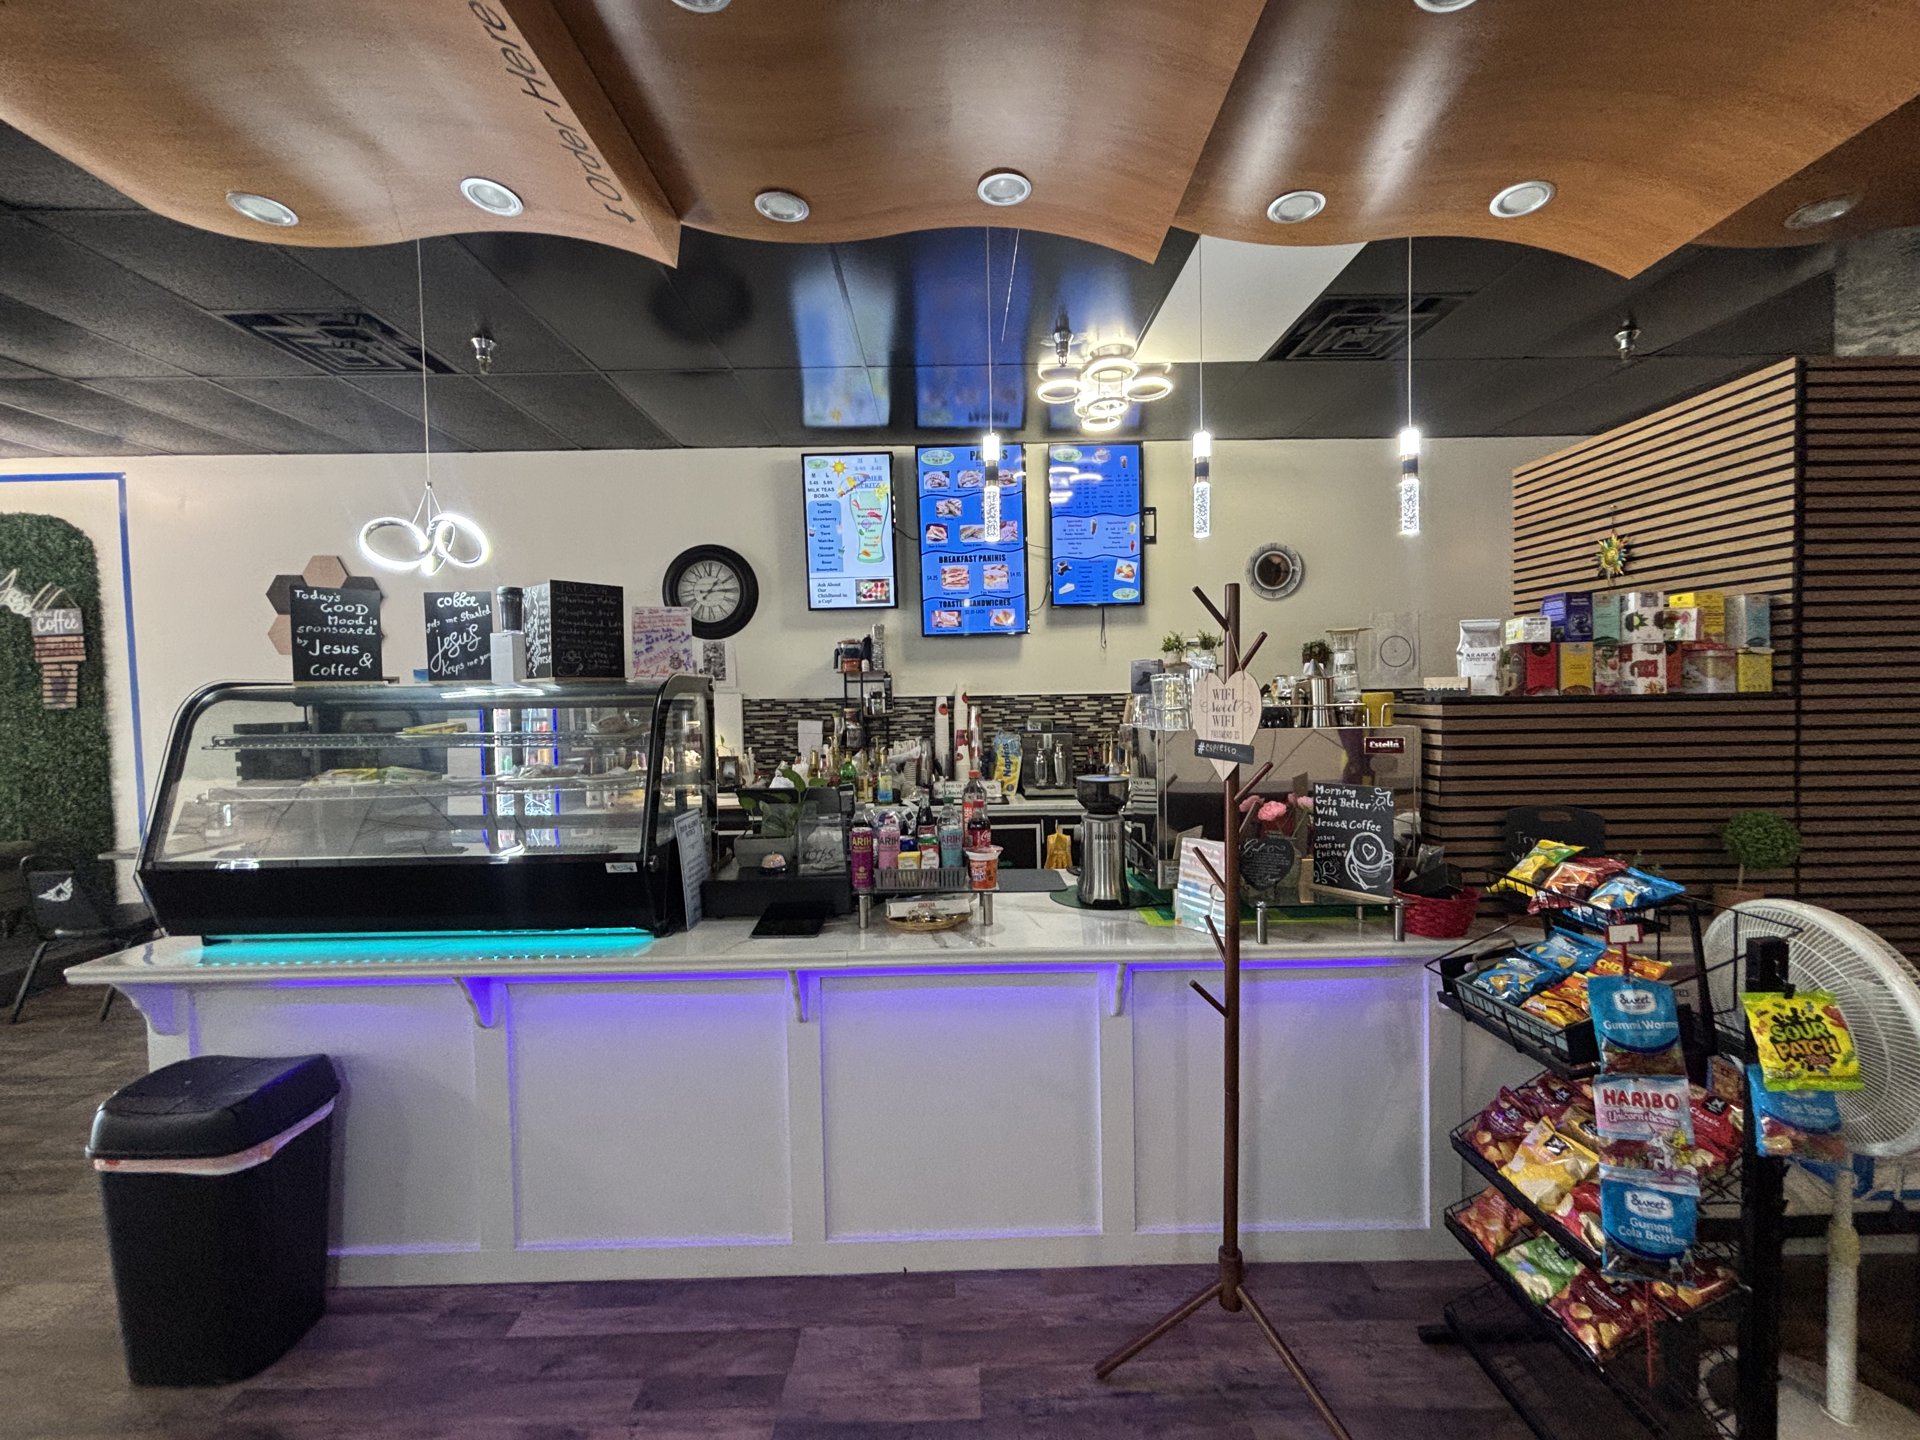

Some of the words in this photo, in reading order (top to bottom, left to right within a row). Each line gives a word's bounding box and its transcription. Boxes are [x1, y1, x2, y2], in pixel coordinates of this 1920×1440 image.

[469, 1, 561, 109] Here
[545, 110, 624, 202] Order
[938, 554, 978, 564] BREAKFAST
[978, 553, 1007, 562] PANINIS
[294, 589, 341, 603] Today's
[320, 603, 369, 615] GOOD
[327, 615, 366, 625] Mood
[369, 616, 378, 625] is
[296, 636, 309, 646] by
[308, 639, 360, 656] Jesus
[358, 652, 373, 668] &
[310, 664, 359, 676] Coffee
[1211, 688, 1235, 701] WIFI
[1211, 715, 1235, 727] WIFI
[1315, 784, 1357, 798] Morning
[1315, 796, 1337, 806] Gets
[1340, 797, 1372, 810] Better
[1315, 806, 1338, 816] With
[1348, 820, 1382, 832] Coffee
[1619, 993, 1652, 1005] Sweet
[1603, 1020, 1640, 1030] Gummi
[1642, 1020, 1679, 1030] Worms
[1771, 1021, 1829, 1042] SOUR
[1775, 1035, 1841, 1060] PATCH
[1602, 1088, 1679, 1111] HARIBO
[1630, 1193, 1666, 1210] Sweet
[1630, 1217, 1671, 1233] Gummi
[1618, 1225, 1643, 1238] Cola
[1645, 1230, 1688, 1246] Bottles
